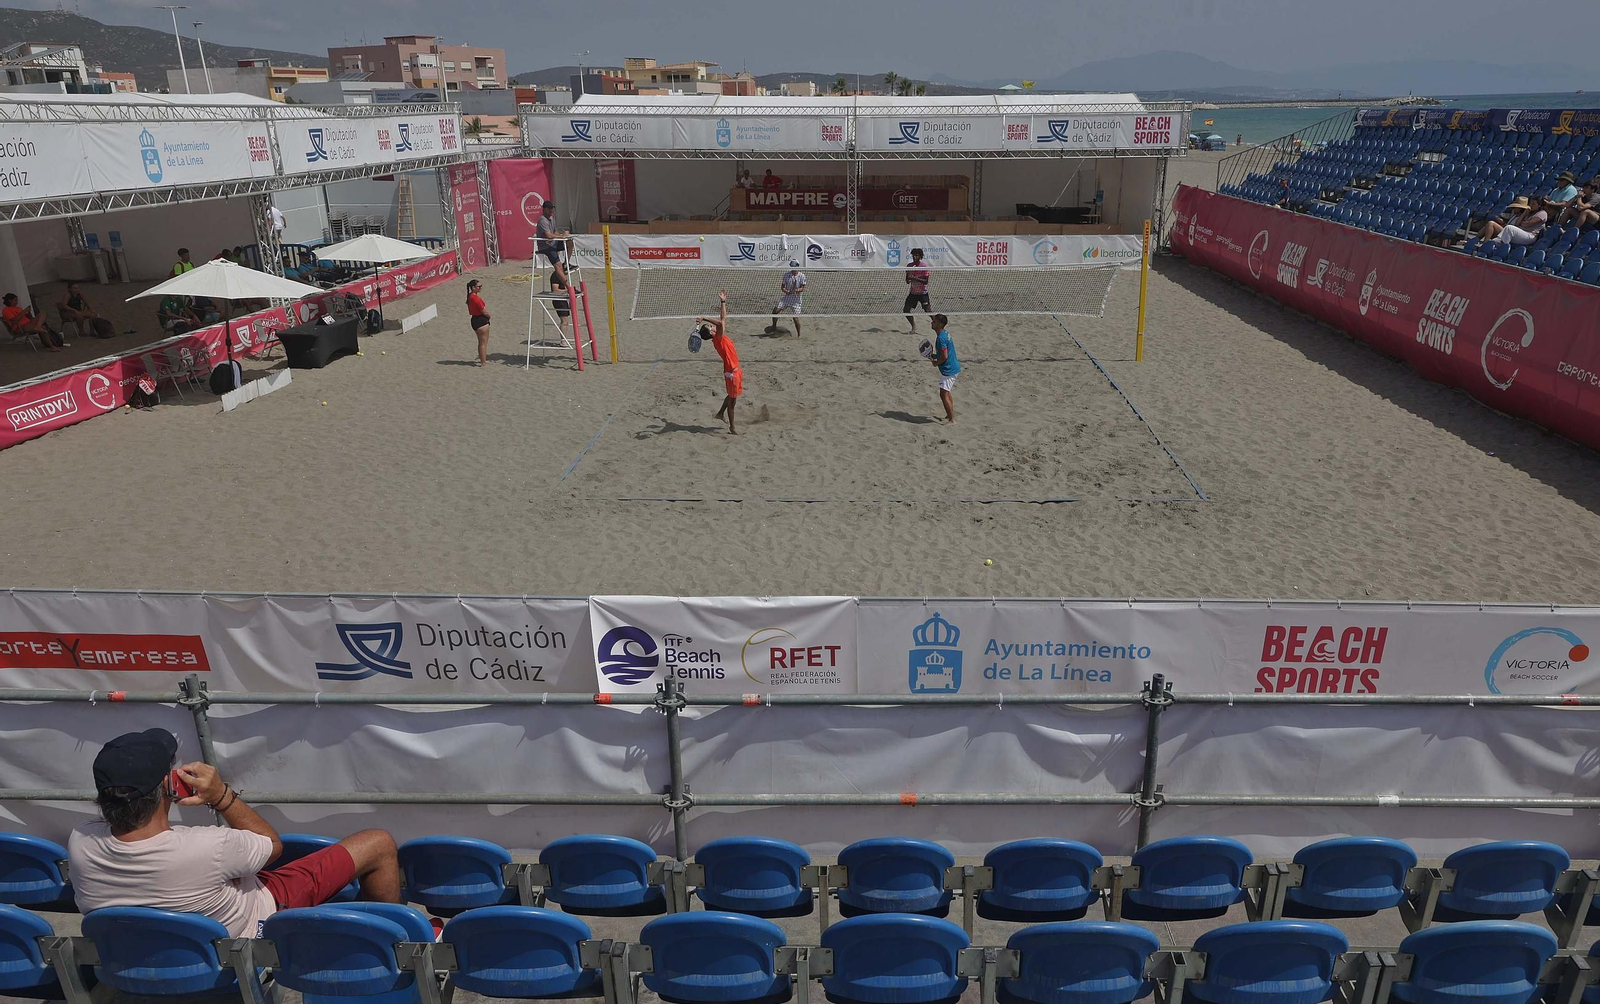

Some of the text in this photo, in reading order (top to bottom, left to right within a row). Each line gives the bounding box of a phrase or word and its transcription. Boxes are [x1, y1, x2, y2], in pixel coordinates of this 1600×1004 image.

[594, 119, 642, 132] Diputación
[735, 125, 780, 133] Ayuntamiento
[923, 121, 972, 132] Diputación
[1007, 124, 1028, 132] BEACH
[1072, 119, 1121, 130] Diputación
[1135, 116, 1171, 130] BEACH
[596, 132, 634, 143] de Cádiz
[821, 133, 843, 142] SPORTS
[923, 134, 963, 145] de Cádiz
[1006, 132, 1028, 141] SPORTS
[1072, 132, 1111, 143] de Cádiz
[1134, 131, 1170, 144] SPORTS
[163, 141, 210, 154] Ayuntamiento
[166, 154, 204, 167] de La Línea
[250, 149, 269, 162] SPORTS
[749, 192, 829, 205] MAPFRE
[899, 195, 918, 203] RFET
[758, 243, 799, 252] Diputaión
[850, 249, 868, 257] RFE
[977, 242, 1008, 254] BEACH
[1100, 249, 1141, 258] Iberdrola
[976, 254, 1008, 265] SPORTS
[1276, 262, 1299, 289] SPORTS
[1376, 284, 1411, 304] Ayuntamiento
[1423, 288, 1470, 327] BEACH
[1416, 317, 1456, 355] SPORTS
[1492, 336, 1520, 353] VICTORIA
[416, 623, 567, 651] Diputación
[664, 638, 684, 646] ITF
[984, 638, 1151, 660] Ayuntamiento
[1261, 625, 1389, 664] BEACH
[665, 648, 721, 663] Beach
[770, 645, 841, 669] RFET
[426, 657, 546, 682] de Cádiz
[1506, 659, 1570, 670] VICTORIA
[665, 664, 725, 679] Tennis
[791, 670, 836, 678] FEDERACIÓN
[983, 662, 1112, 683] de La Línea
[771, 677, 808, 685] ESPAÑOLA
[1254, 666, 1380, 693] SPORTS
